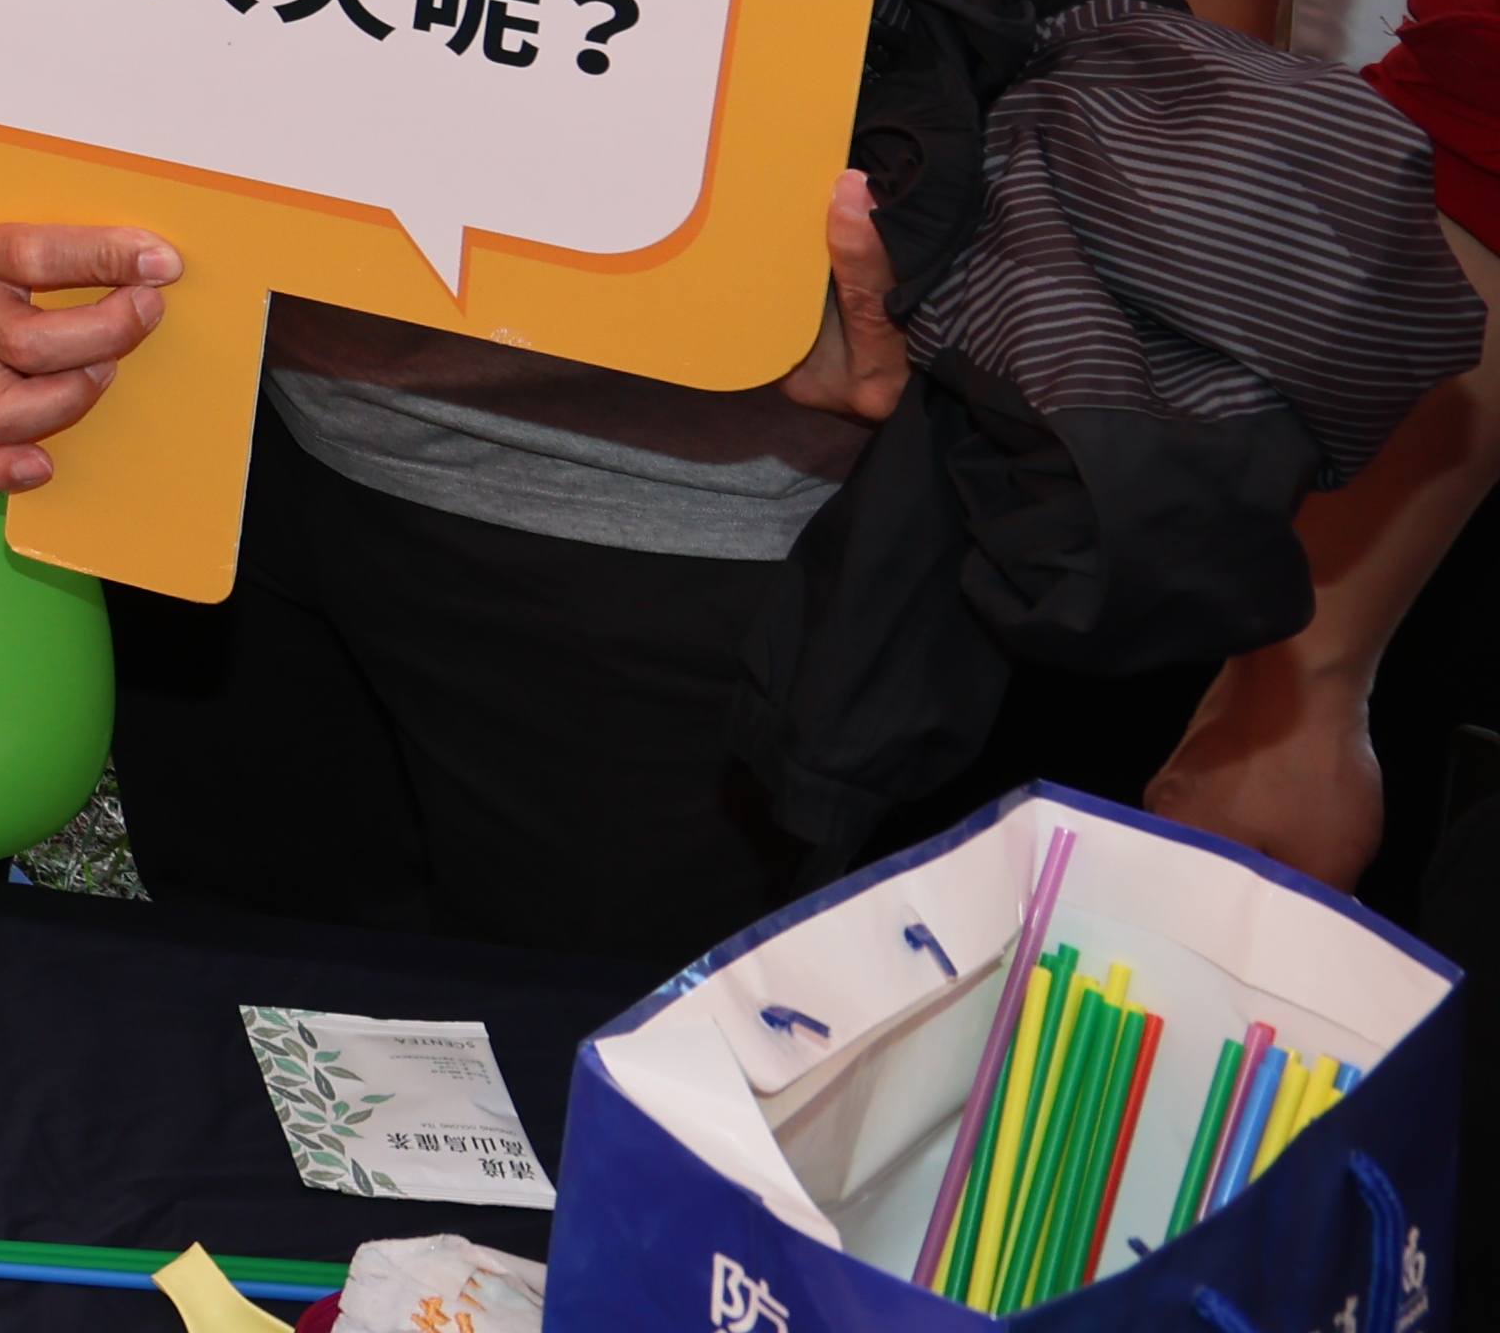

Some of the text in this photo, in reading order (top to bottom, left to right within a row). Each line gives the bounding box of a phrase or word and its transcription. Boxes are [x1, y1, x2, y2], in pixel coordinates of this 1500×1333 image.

[384, 1132, 528, 1160] 高山烏龍茶
[478, 1156, 537, 1181] 清境
